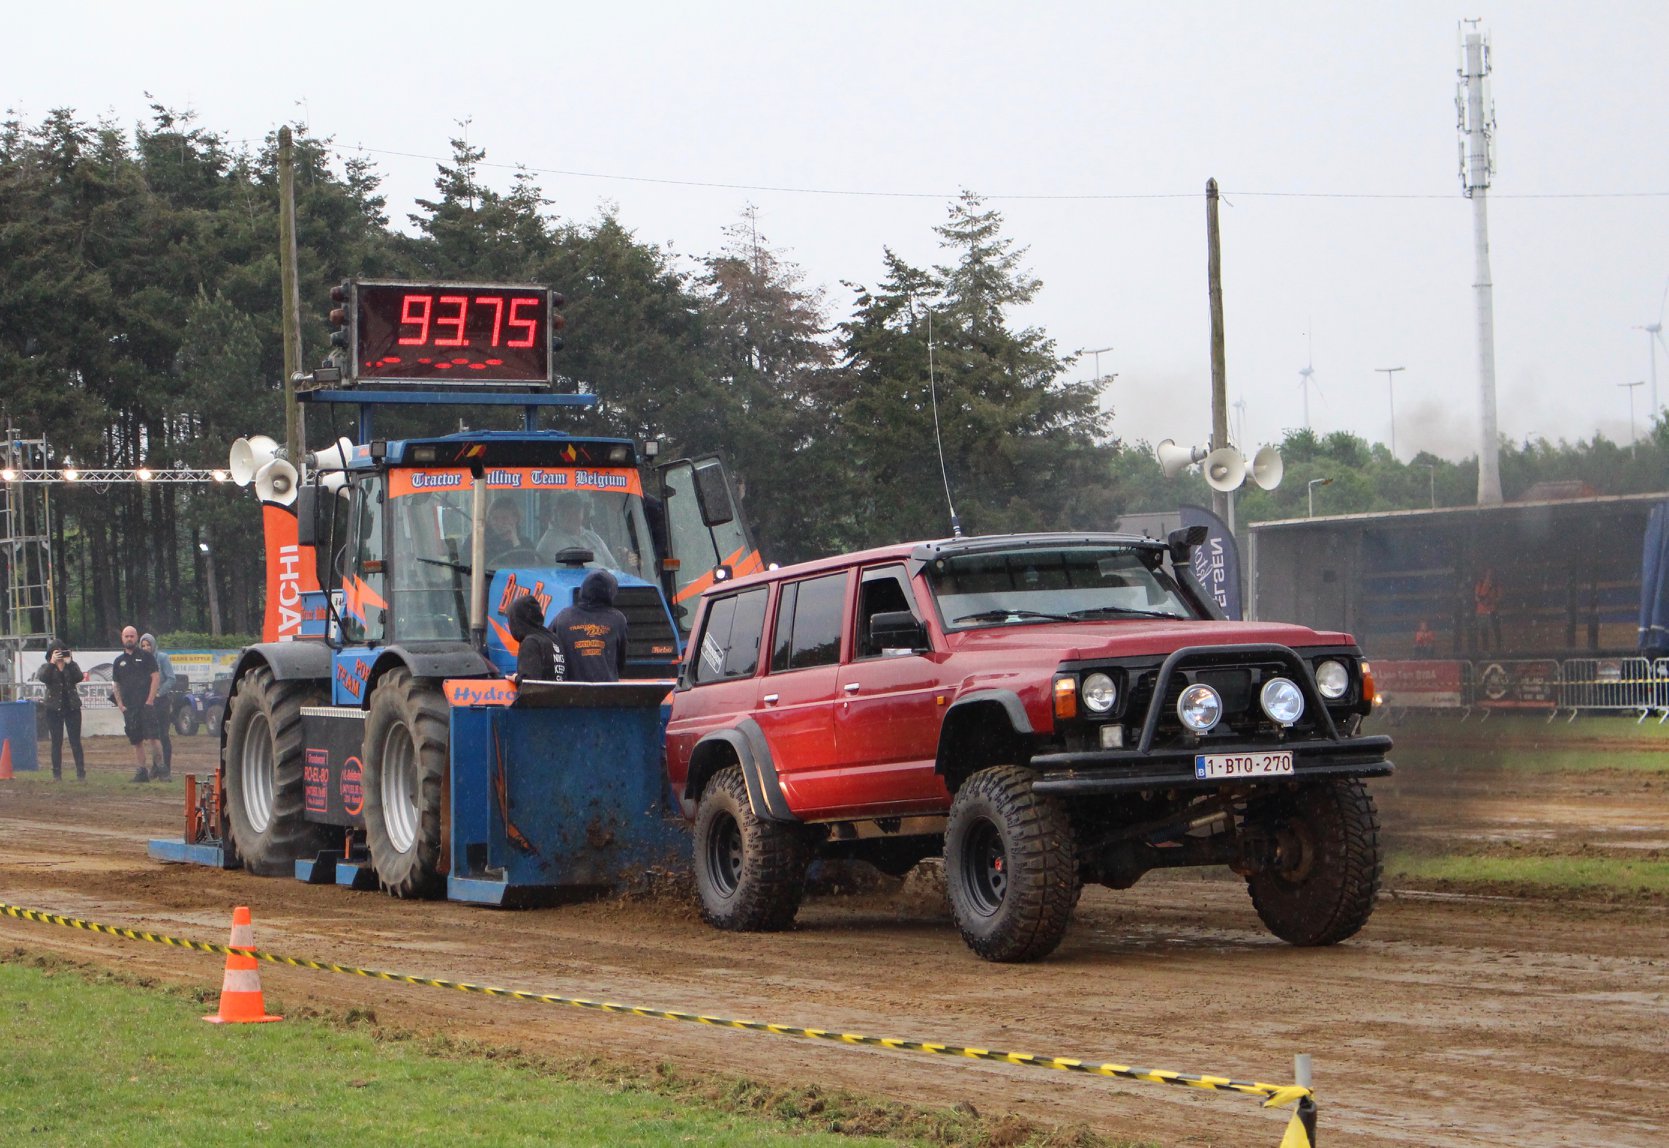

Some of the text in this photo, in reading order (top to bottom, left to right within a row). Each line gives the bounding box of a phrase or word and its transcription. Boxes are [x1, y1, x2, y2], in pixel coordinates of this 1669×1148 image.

[411, 469, 628, 488] Tractor lling Team Belgium
[454, 687, 520, 703] Hydro
[1198, 768, 1205, 777] B
